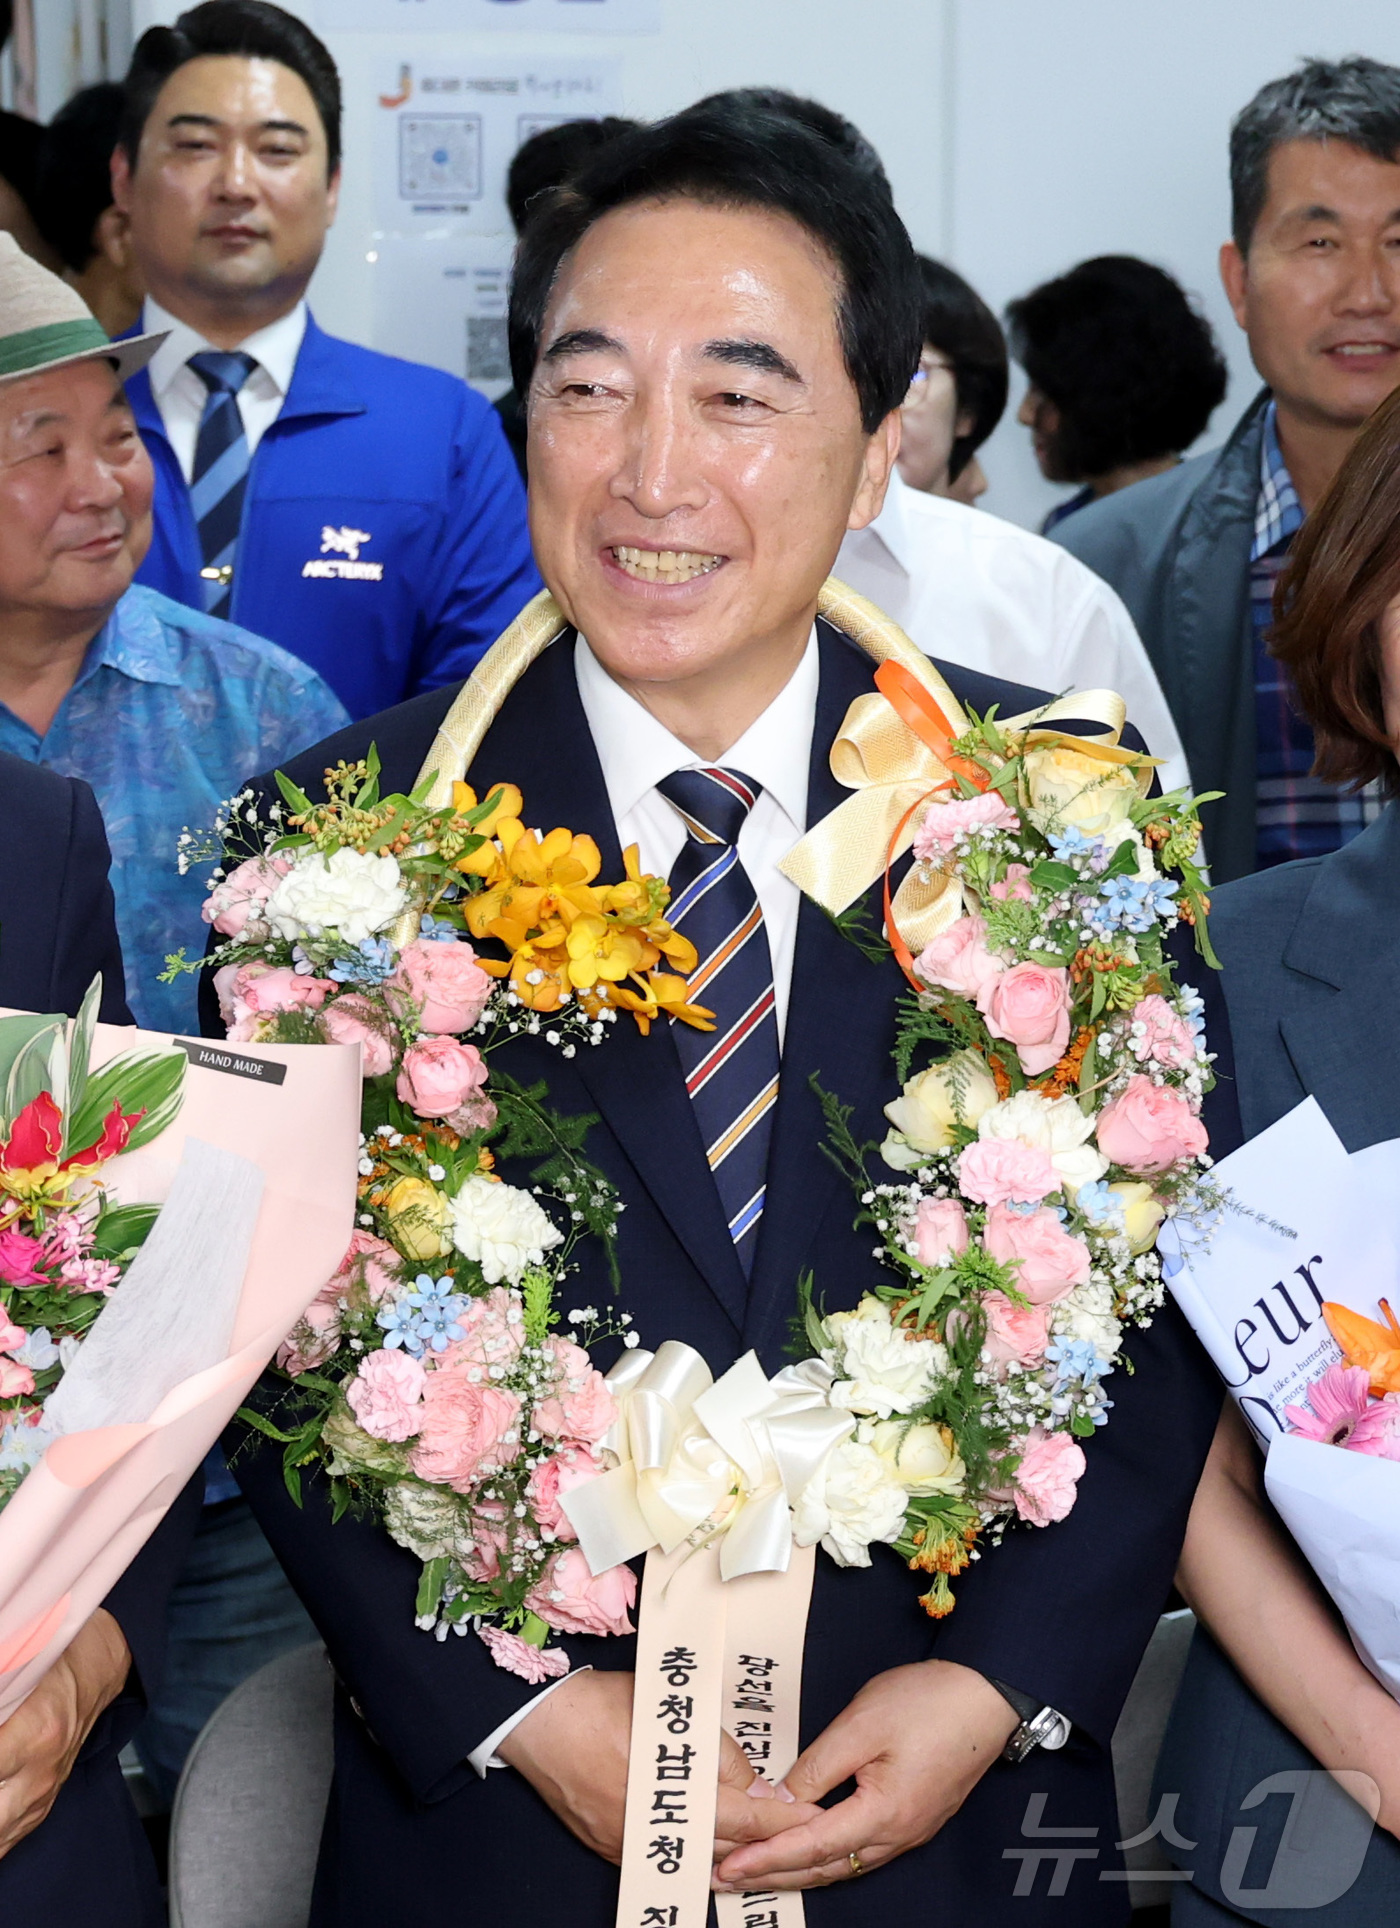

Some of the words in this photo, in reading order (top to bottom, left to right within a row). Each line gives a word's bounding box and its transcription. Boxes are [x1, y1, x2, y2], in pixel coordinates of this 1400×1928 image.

[199, 1050, 232, 1068] HAND
[232, 1059, 264, 1076] MADE
[1273, 1376, 1290, 1393] like
[1290, 1371, 1298, 1379] a
[1282, 1384, 1305, 1405] more
[1312, 1359, 1330, 1378] will
[1330, 1349, 1345, 1364] elu
[731, 1654, 780, 1713] 당선을
[646, 1646, 698, 1875] 충청남도청
